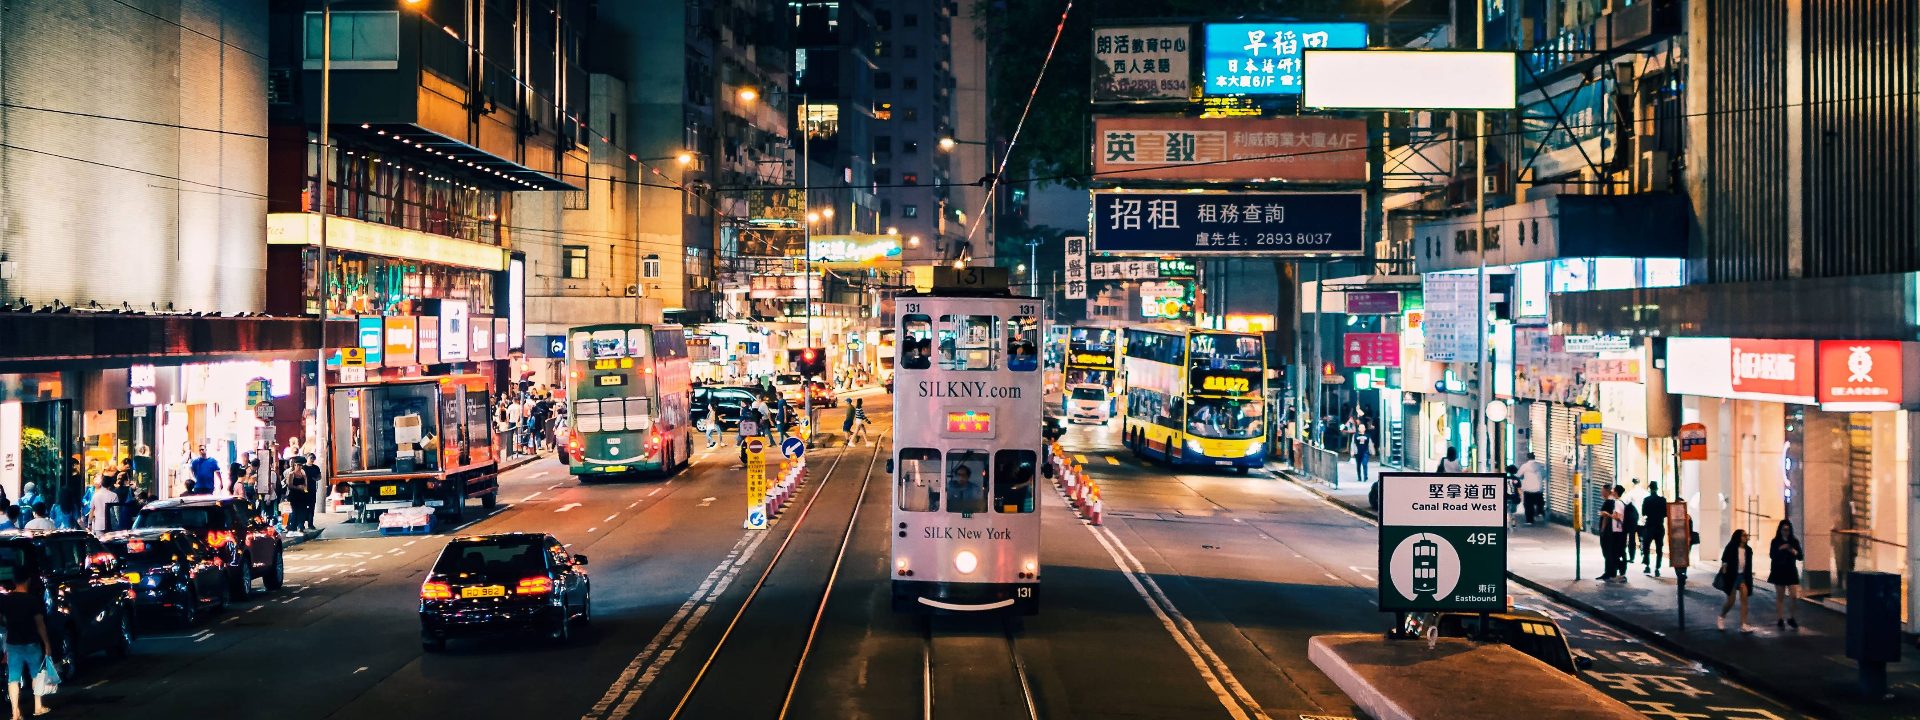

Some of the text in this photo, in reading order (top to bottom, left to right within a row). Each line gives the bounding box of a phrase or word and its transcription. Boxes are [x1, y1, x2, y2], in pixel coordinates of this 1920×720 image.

[1096, 35, 1187, 54] 朗活教育中心
[1109, 198, 1285, 231] 招租 租務查詢
[1256, 233, 1293, 246] 2893
[1296, 233, 1333, 246] 8037
[956, 266, 986, 285] 131
[905, 303, 921, 313] 131
[1019, 305, 1036, 315] 131
[919, 380, 1022, 399] SILKNY.com
[1428, 483, 1497, 499] 堅拿道西
[1411, 502, 1497, 511] Canal Road West
[923, 526, 1012, 540] SILK New York
[1466, 533, 1497, 545] 49E
[1017, 587, 1032, 598] 131
[1478, 584, 1497, 594] 東行
[1455, 595, 1497, 603] Eastbound
